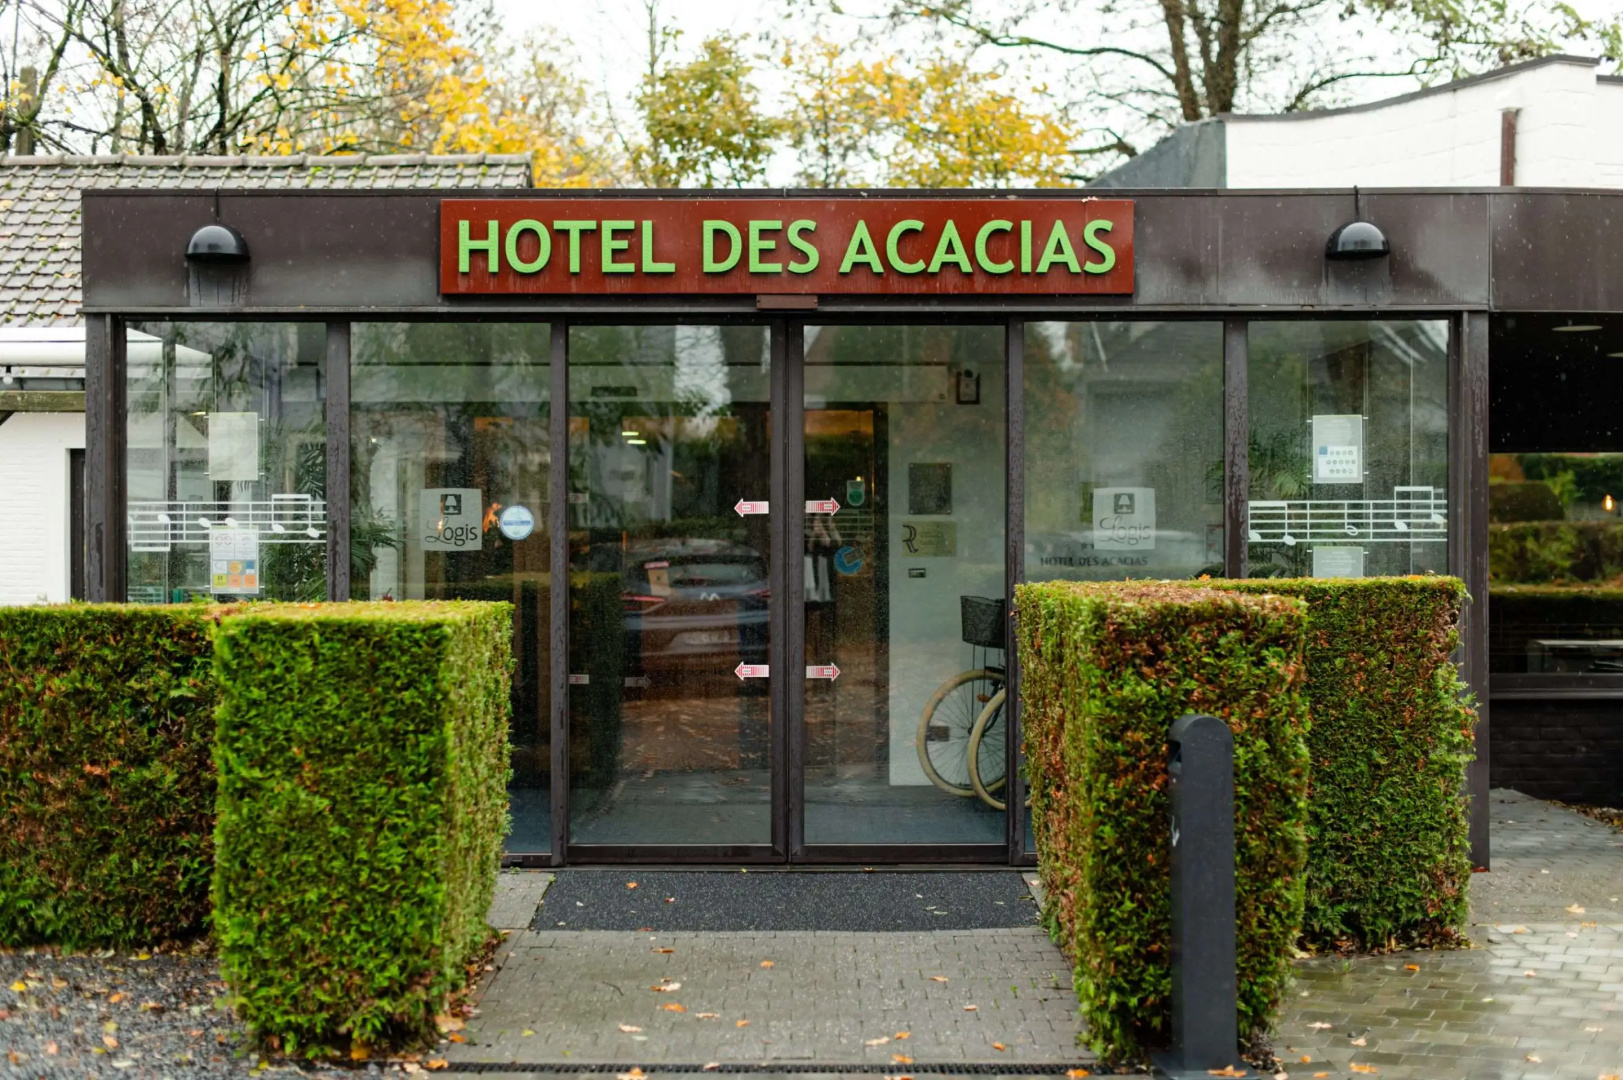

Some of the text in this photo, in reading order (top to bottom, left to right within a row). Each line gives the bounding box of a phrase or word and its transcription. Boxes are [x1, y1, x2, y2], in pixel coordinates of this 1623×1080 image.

[458, 220, 1116, 274] HOTEL DES ACACIAS
[424, 516, 478, 547] Logis
[1099, 515, 1152, 546] Logis
[1040, 556, 1148, 567] HOTEL DES ACACIAS
